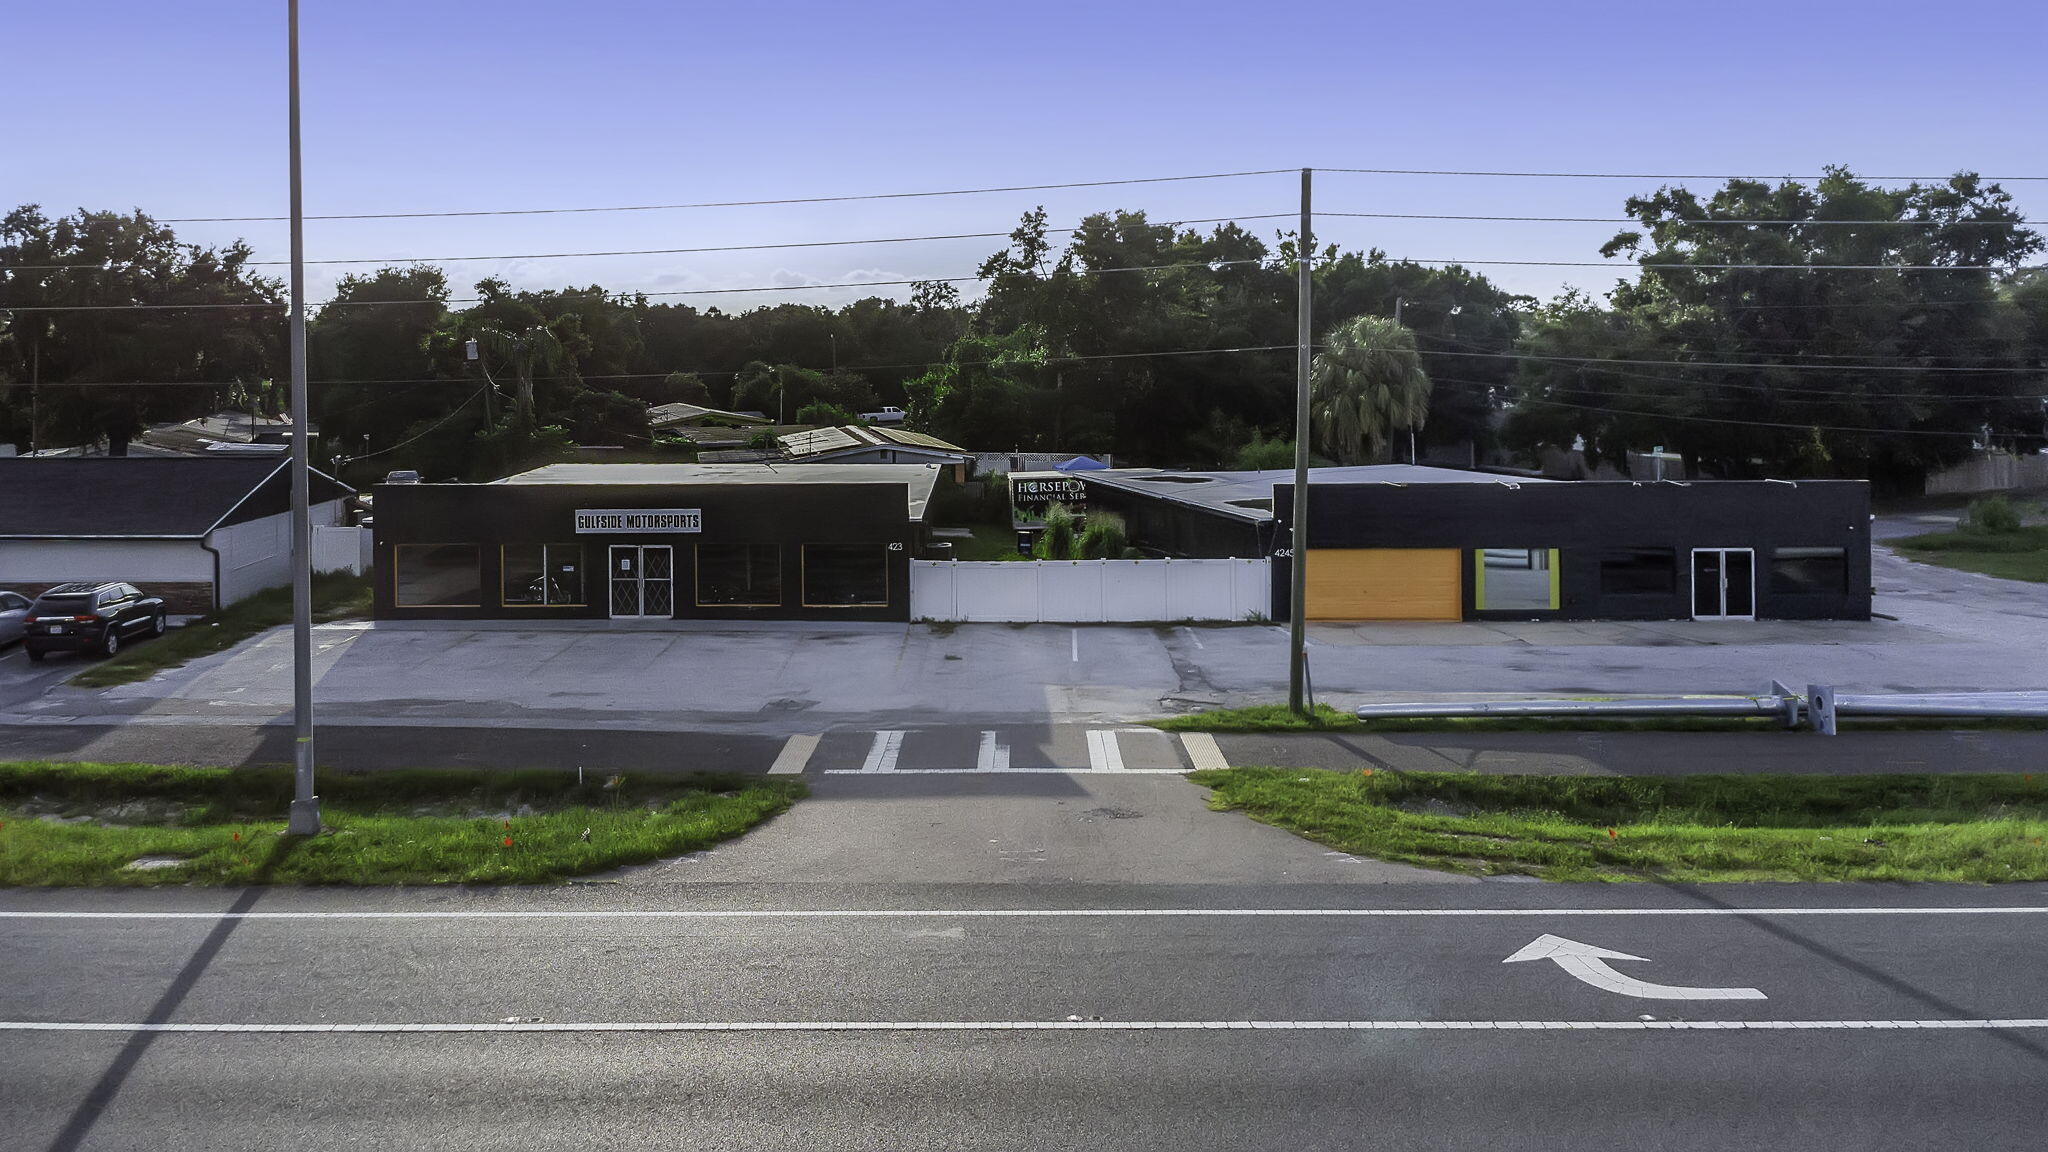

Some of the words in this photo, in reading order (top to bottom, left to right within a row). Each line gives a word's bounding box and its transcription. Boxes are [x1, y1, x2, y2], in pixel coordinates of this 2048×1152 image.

[578, 515, 622, 529] GULFSIDE
[626, 514, 699, 528] MOTORSPORTS
[888, 542, 903, 551] 423
